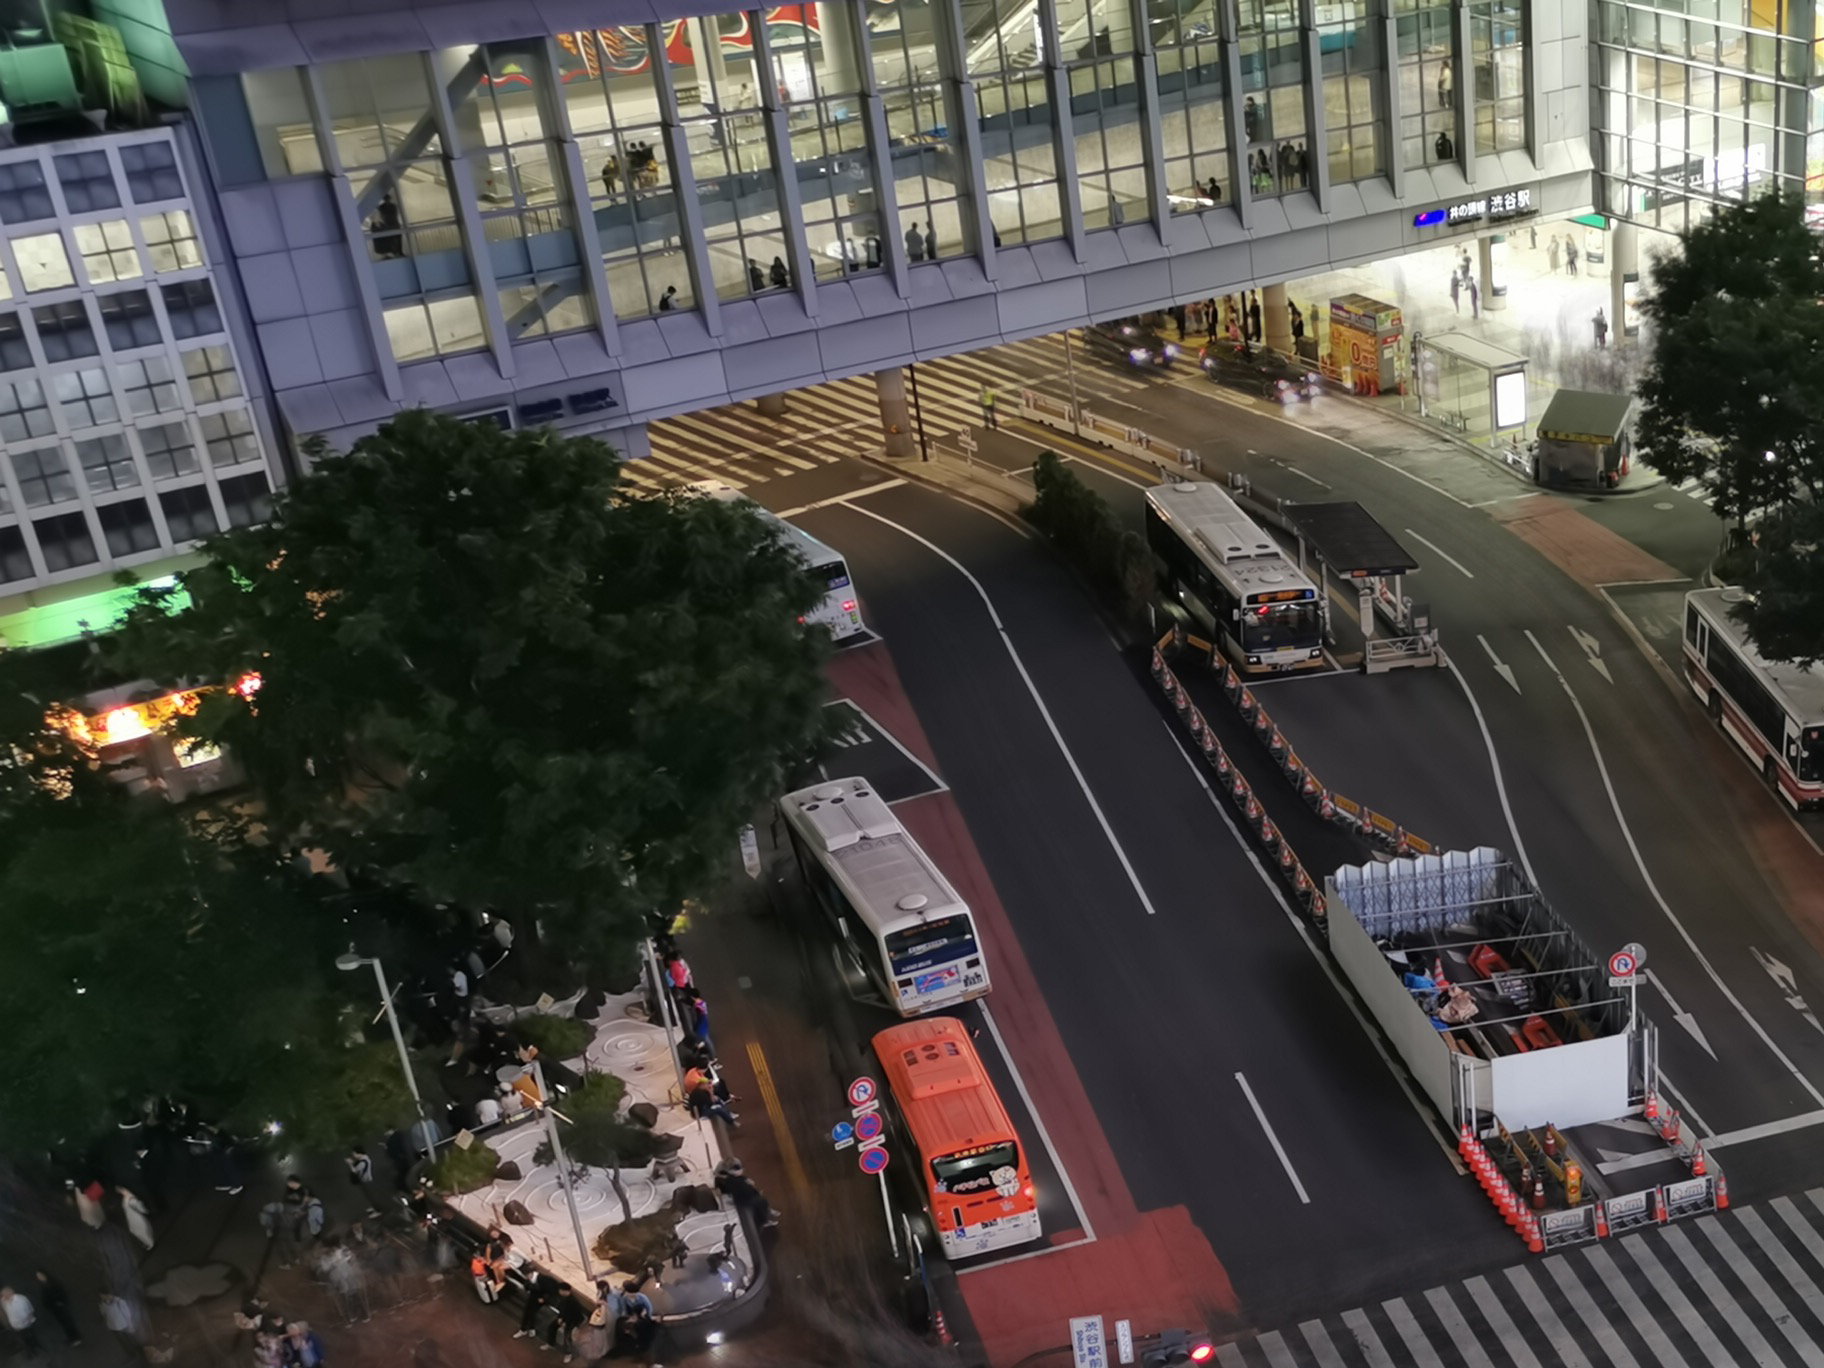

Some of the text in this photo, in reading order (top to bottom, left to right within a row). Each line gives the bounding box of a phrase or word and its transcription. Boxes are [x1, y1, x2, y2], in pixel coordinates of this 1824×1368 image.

[1490, 189, 1531, 223] 渋谷駅
[1084, 1321, 1103, 1368] 渋谷駅前
